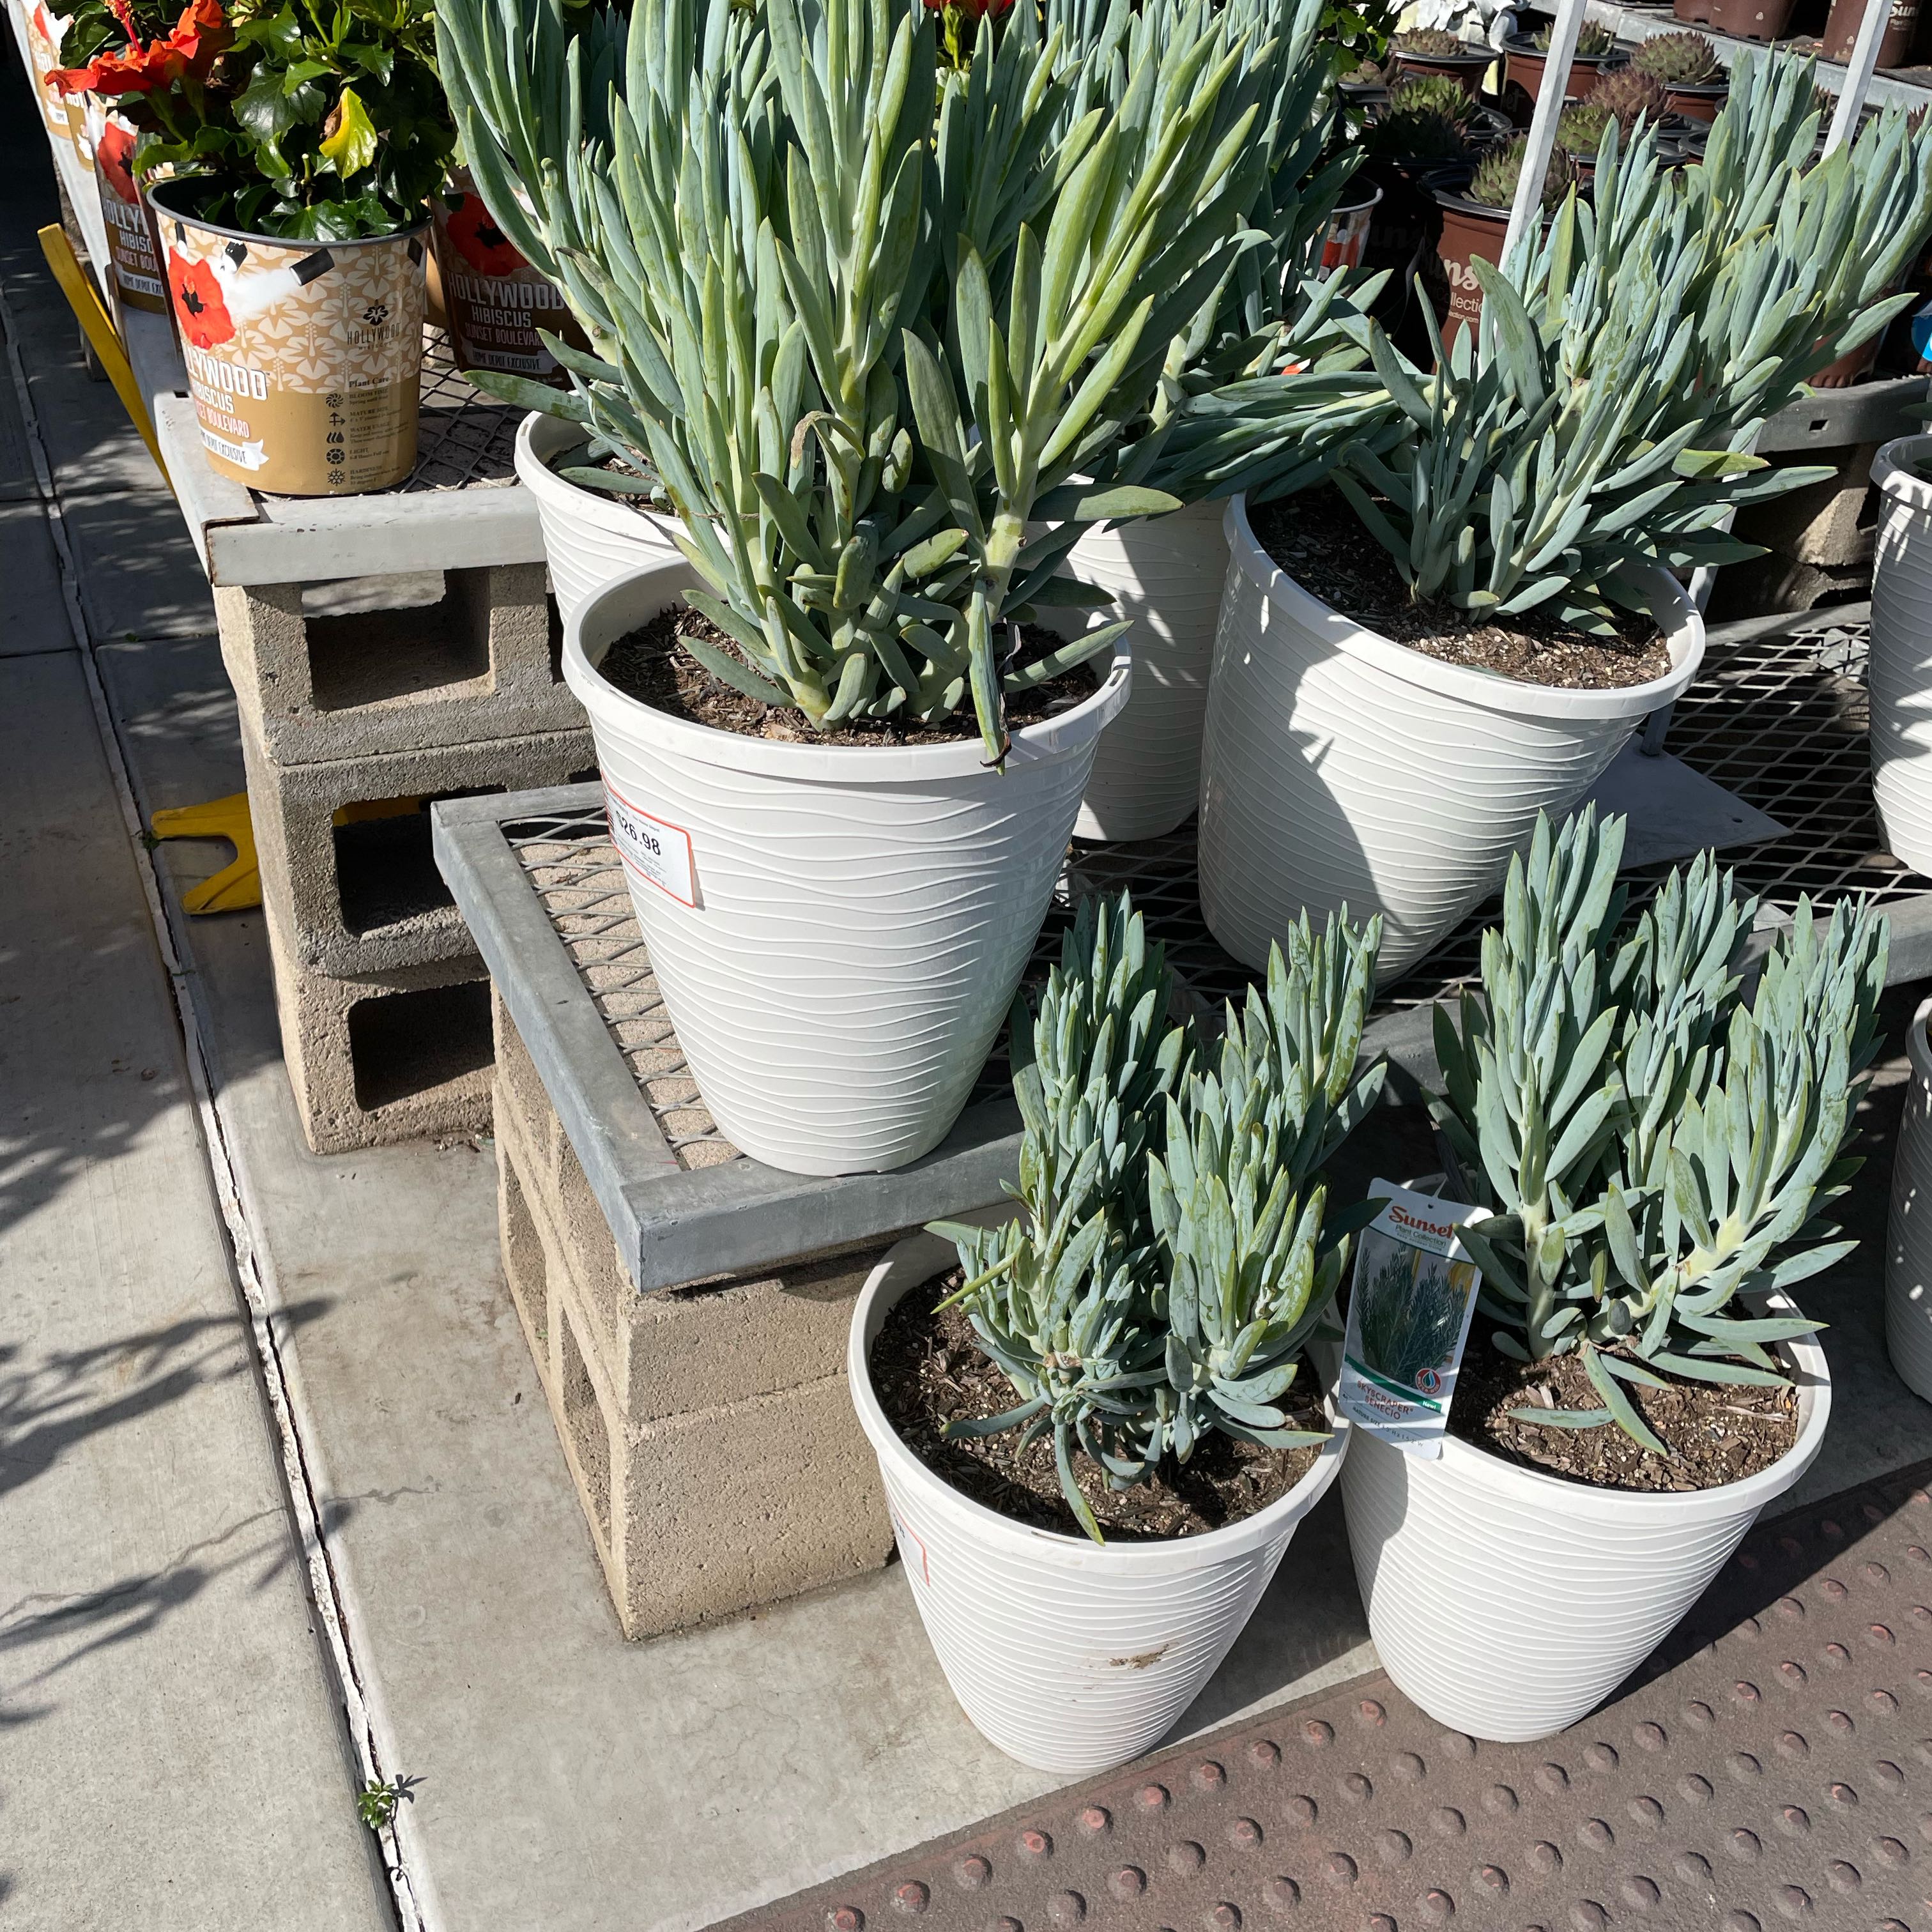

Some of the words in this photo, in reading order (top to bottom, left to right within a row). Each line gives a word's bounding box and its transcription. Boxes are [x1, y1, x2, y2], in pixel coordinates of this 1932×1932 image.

[119, 230, 153, 254] HIBISC
[471, 305, 532, 328] HIBISCUS
[347, 322, 401, 345] HOLLYWOOD
[464, 322, 492, 342] SUNSET
[495, 328, 544, 347] BOULEVAR
[507, 357, 540, 370] EXCLUSIVE
[349, 378, 371, 387] Plant
[372, 376, 389, 385] Care
[1395, 1224, 1412, 1235] Plant
[1413, 1230, 1447, 1247] Collection
[1365, 1395, 1401, 1420] SENECIO
